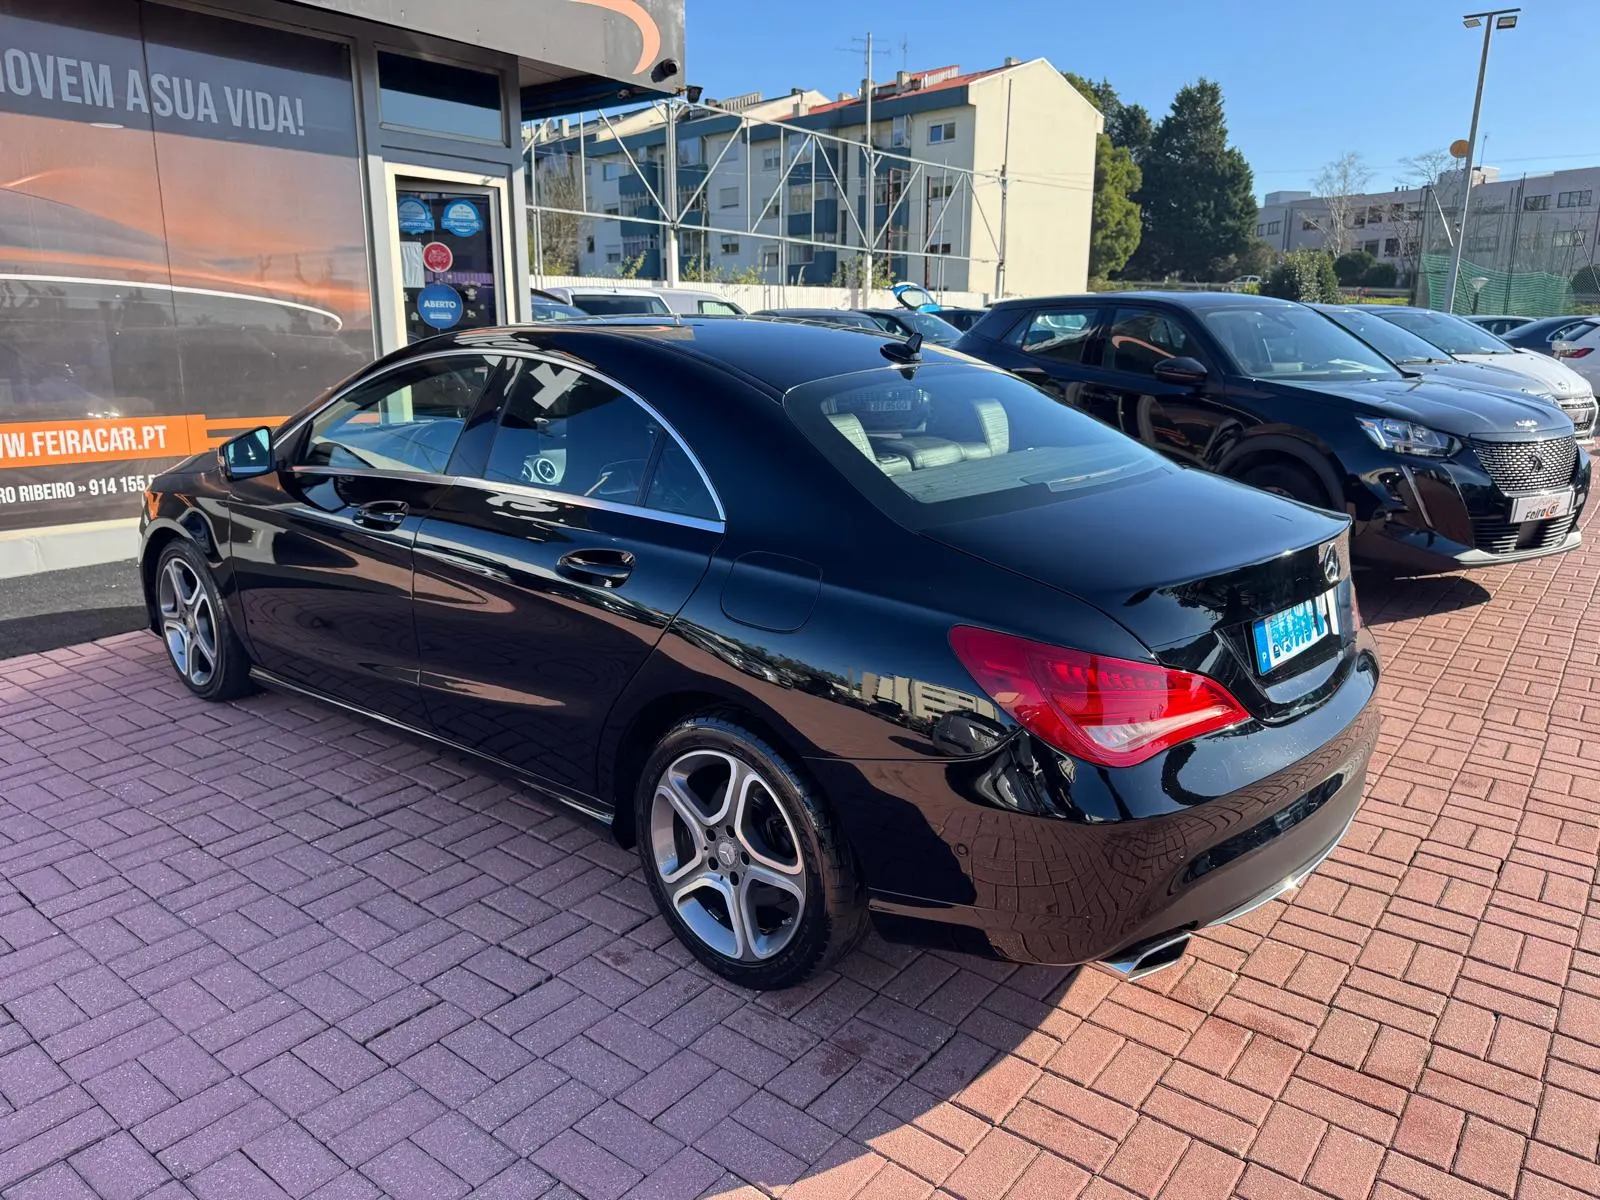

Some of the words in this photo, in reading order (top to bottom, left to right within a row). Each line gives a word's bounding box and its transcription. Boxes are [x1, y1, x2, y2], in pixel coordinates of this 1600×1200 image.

[0, 48, 114, 109] OVEM
[223, 86, 305, 136] VIDA!
[424, 299, 457, 309] ABERTO
[0, 424, 167, 459] W.FEIRACAR.PT
[18, 481, 76, 502] RIBEIRO
[88, 477, 117, 496] 914
[119, 475, 146, 493] 155
